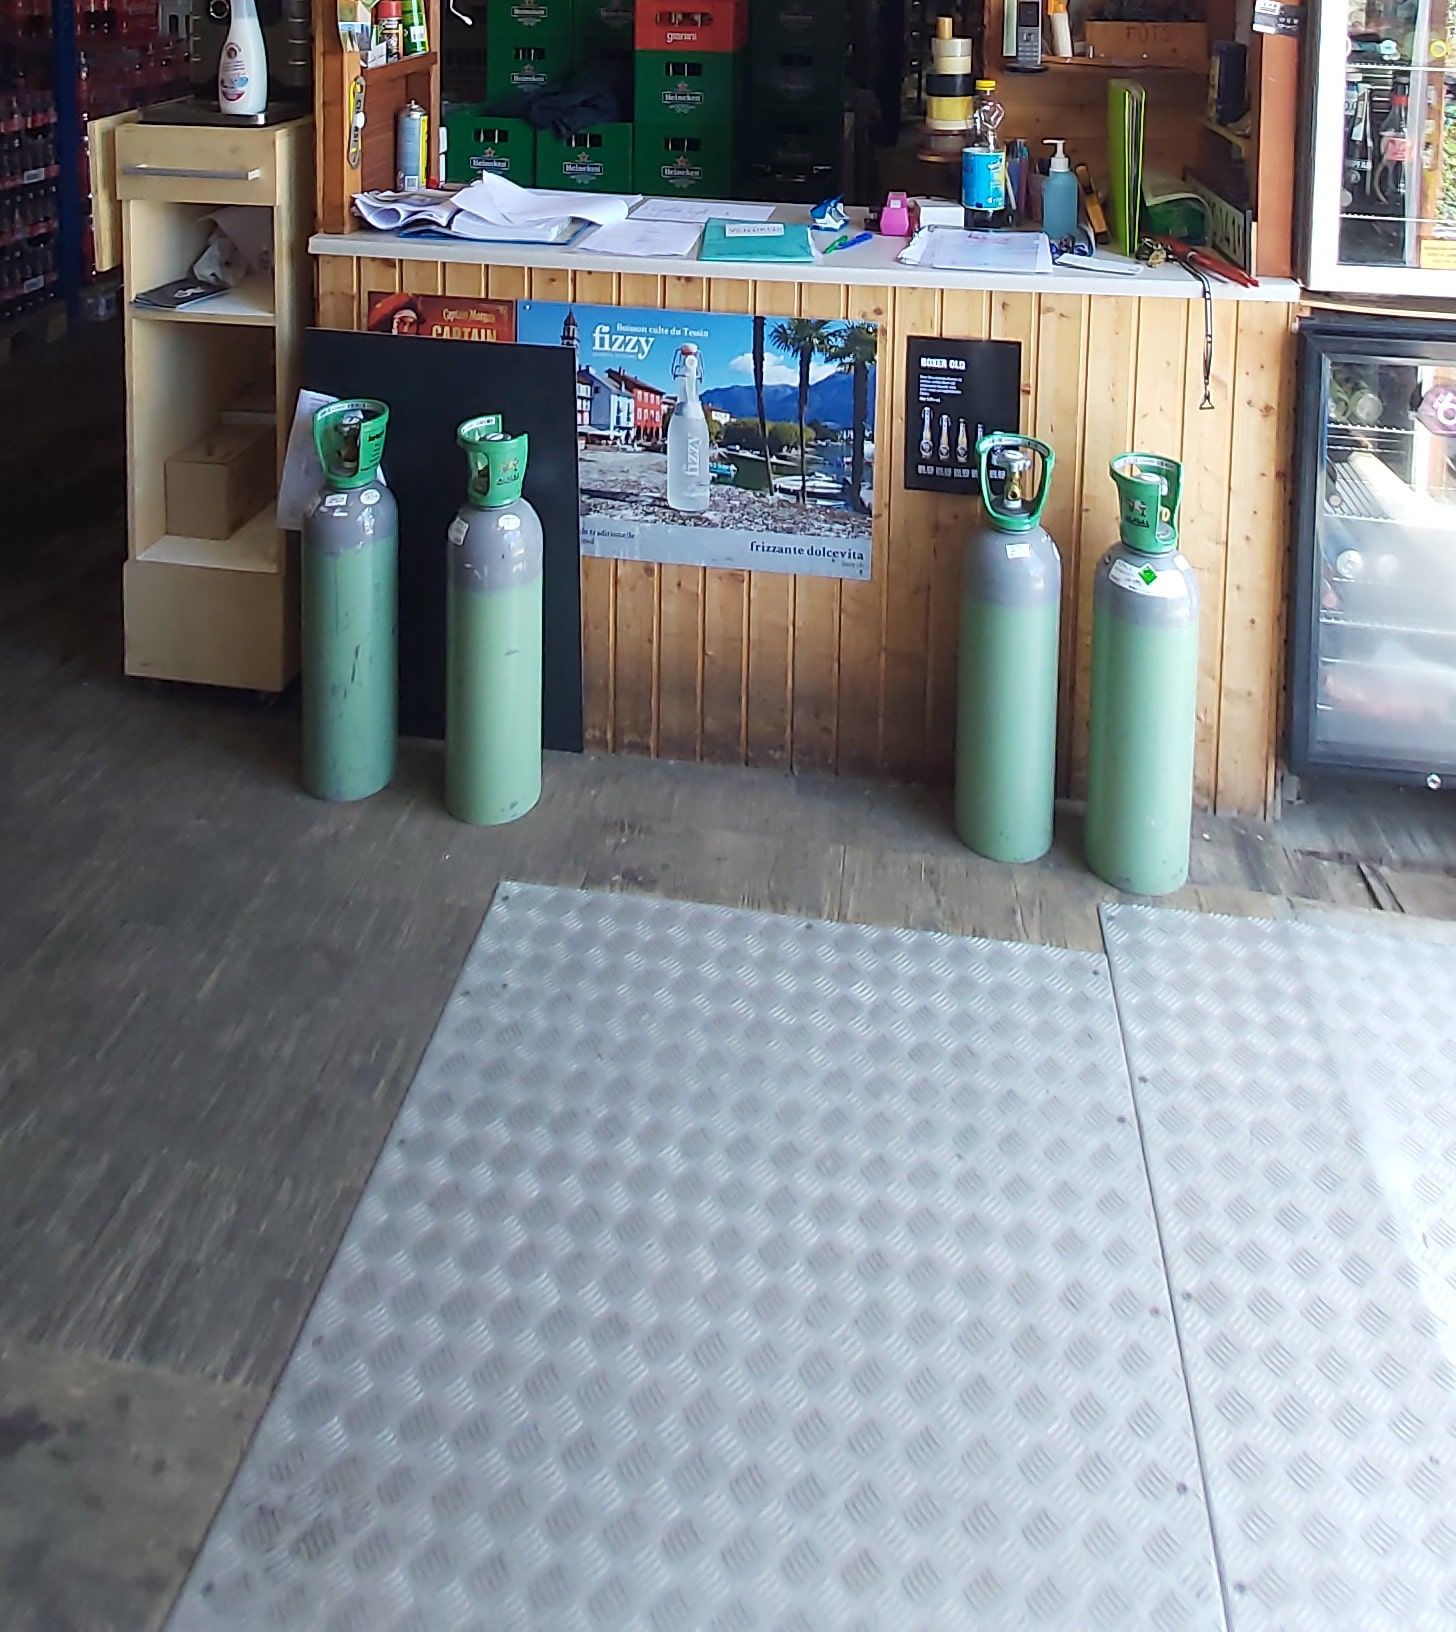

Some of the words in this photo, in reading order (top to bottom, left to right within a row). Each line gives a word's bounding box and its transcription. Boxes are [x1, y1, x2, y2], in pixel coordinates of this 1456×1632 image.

[665, 92, 701, 102] Heineken
[472, 159, 507, 168] Heineken
[566, 163, 601, 173] Heineken
[664, 167, 700, 177] Heineken
[669, 327, 682, 336] du
[592, 324, 655, 360] fizzy
[920, 357, 948, 369] BOXER
[682, 432, 702, 477] fizzy
[750, 540, 805, 556] frizzante
[806, 545, 864, 561] dolcevita
